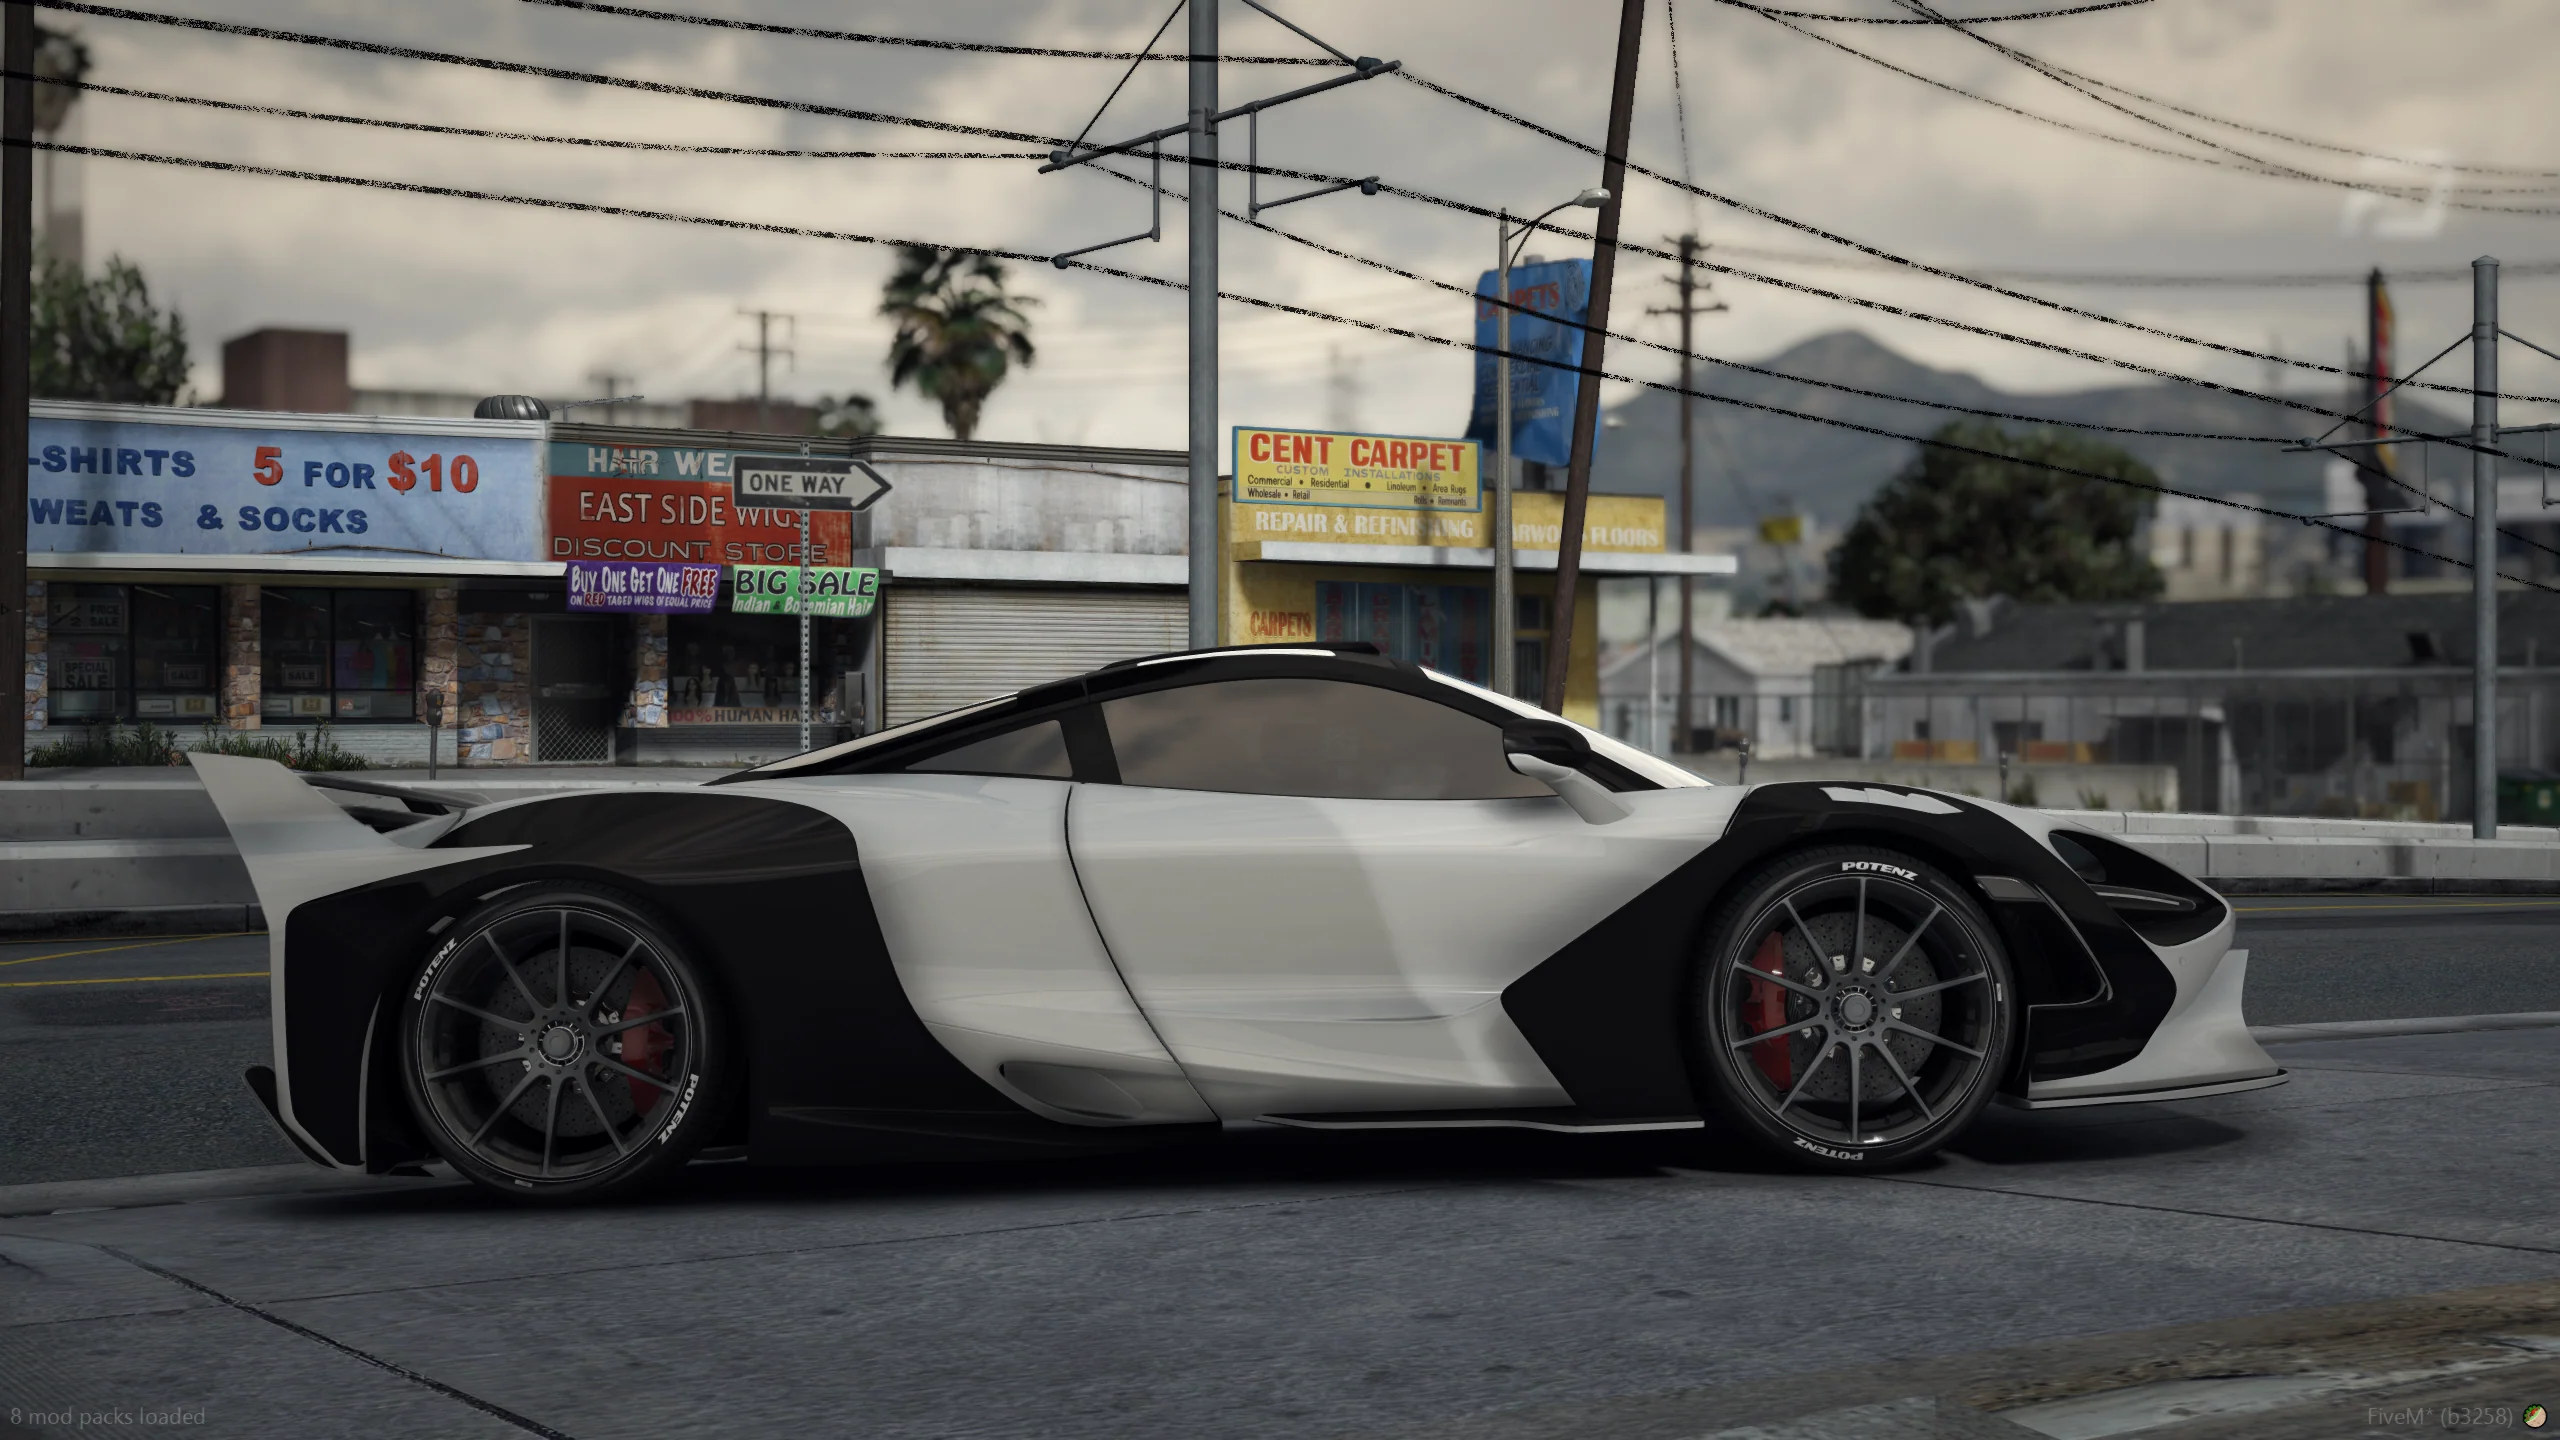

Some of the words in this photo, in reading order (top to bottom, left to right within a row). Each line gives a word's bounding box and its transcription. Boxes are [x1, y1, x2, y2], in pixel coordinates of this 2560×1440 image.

[587, 447, 659, 475] HAIR
[1249, 433, 1334, 465] CENT
[1350, 438, 1465, 472] CARPET
[253, 446, 284, 486] 5
[303, 461, 376, 489] FOR
[387, 450, 479, 495] $10
[1276, 465, 1329, 476] CUSTOM
[1343, 467, 1441, 481] INSTALLATIONS
[750, 473, 793, 492] ONE
[802, 475, 845, 494] WAY
[1247, 474, 1292, 486] Commercial
[1311, 477, 1349, 488] Residential
[1386, 482, 1416, 492] Linoleum
[1433, 484, 1448, 493] Area
[1451, 484, 1467, 496] Rugs
[1248, 488, 1281, 499] Wholesale
[1293, 489, 1310, 500] Retail
[1438, 496, 1467, 506] Remnants
[29, 498, 163, 528] WEATS
[196, 504, 224, 530] &
[238, 505, 369, 535] SOCKS
[580, 491, 653, 523] EAST
[661, 494, 726, 526] SIDE
[1255, 511, 1327, 533] REPAIR
[1334, 514, 1348, 533] &
[1355, 515, 1474, 538] REFINISHING
[1591, 526, 1659, 547] FLOORS
[554, 536, 712, 560] DISCOUNT
[571, 565, 597, 593] BUY
[602, 566, 626, 593] ONE
[630, 566, 653, 594] GET
[657, 567, 680, 594] ONE
[681, 567, 718, 598] FREE
[735, 569, 788, 595] BIG
[90, 604, 119, 615] PRICE
[570, 595, 582, 606] ON
[585, 592, 605, 606] RED
[607, 595, 632, 606] TAGED
[634, 595, 654, 606] WIGS
[665, 597, 689, 607] EQUAL
[690, 597, 712, 608] PRICE
[732, 596, 770, 612] Indian
[784, 596, 845, 615] Boemian
[847, 596, 874, 615] Hair
[90, 617, 119, 627] SALE
[1250, 611, 1312, 637] CARPETS
[65, 662, 108, 673] SPECIAL
[287, 671, 315, 681] SALE
[66, 674, 108, 690] SALE
[668, 709, 712, 723] 100%
[714, 709, 773, 723] HUMAN
[779, 710, 816, 723] HAR
[1842, 861, 1919, 881] POTENZ
[413, 937, 457, 1001] POTENZ
[658, 1073, 699, 1145] POTENZ
[1793, 1136, 1864, 1160] POTENZ
